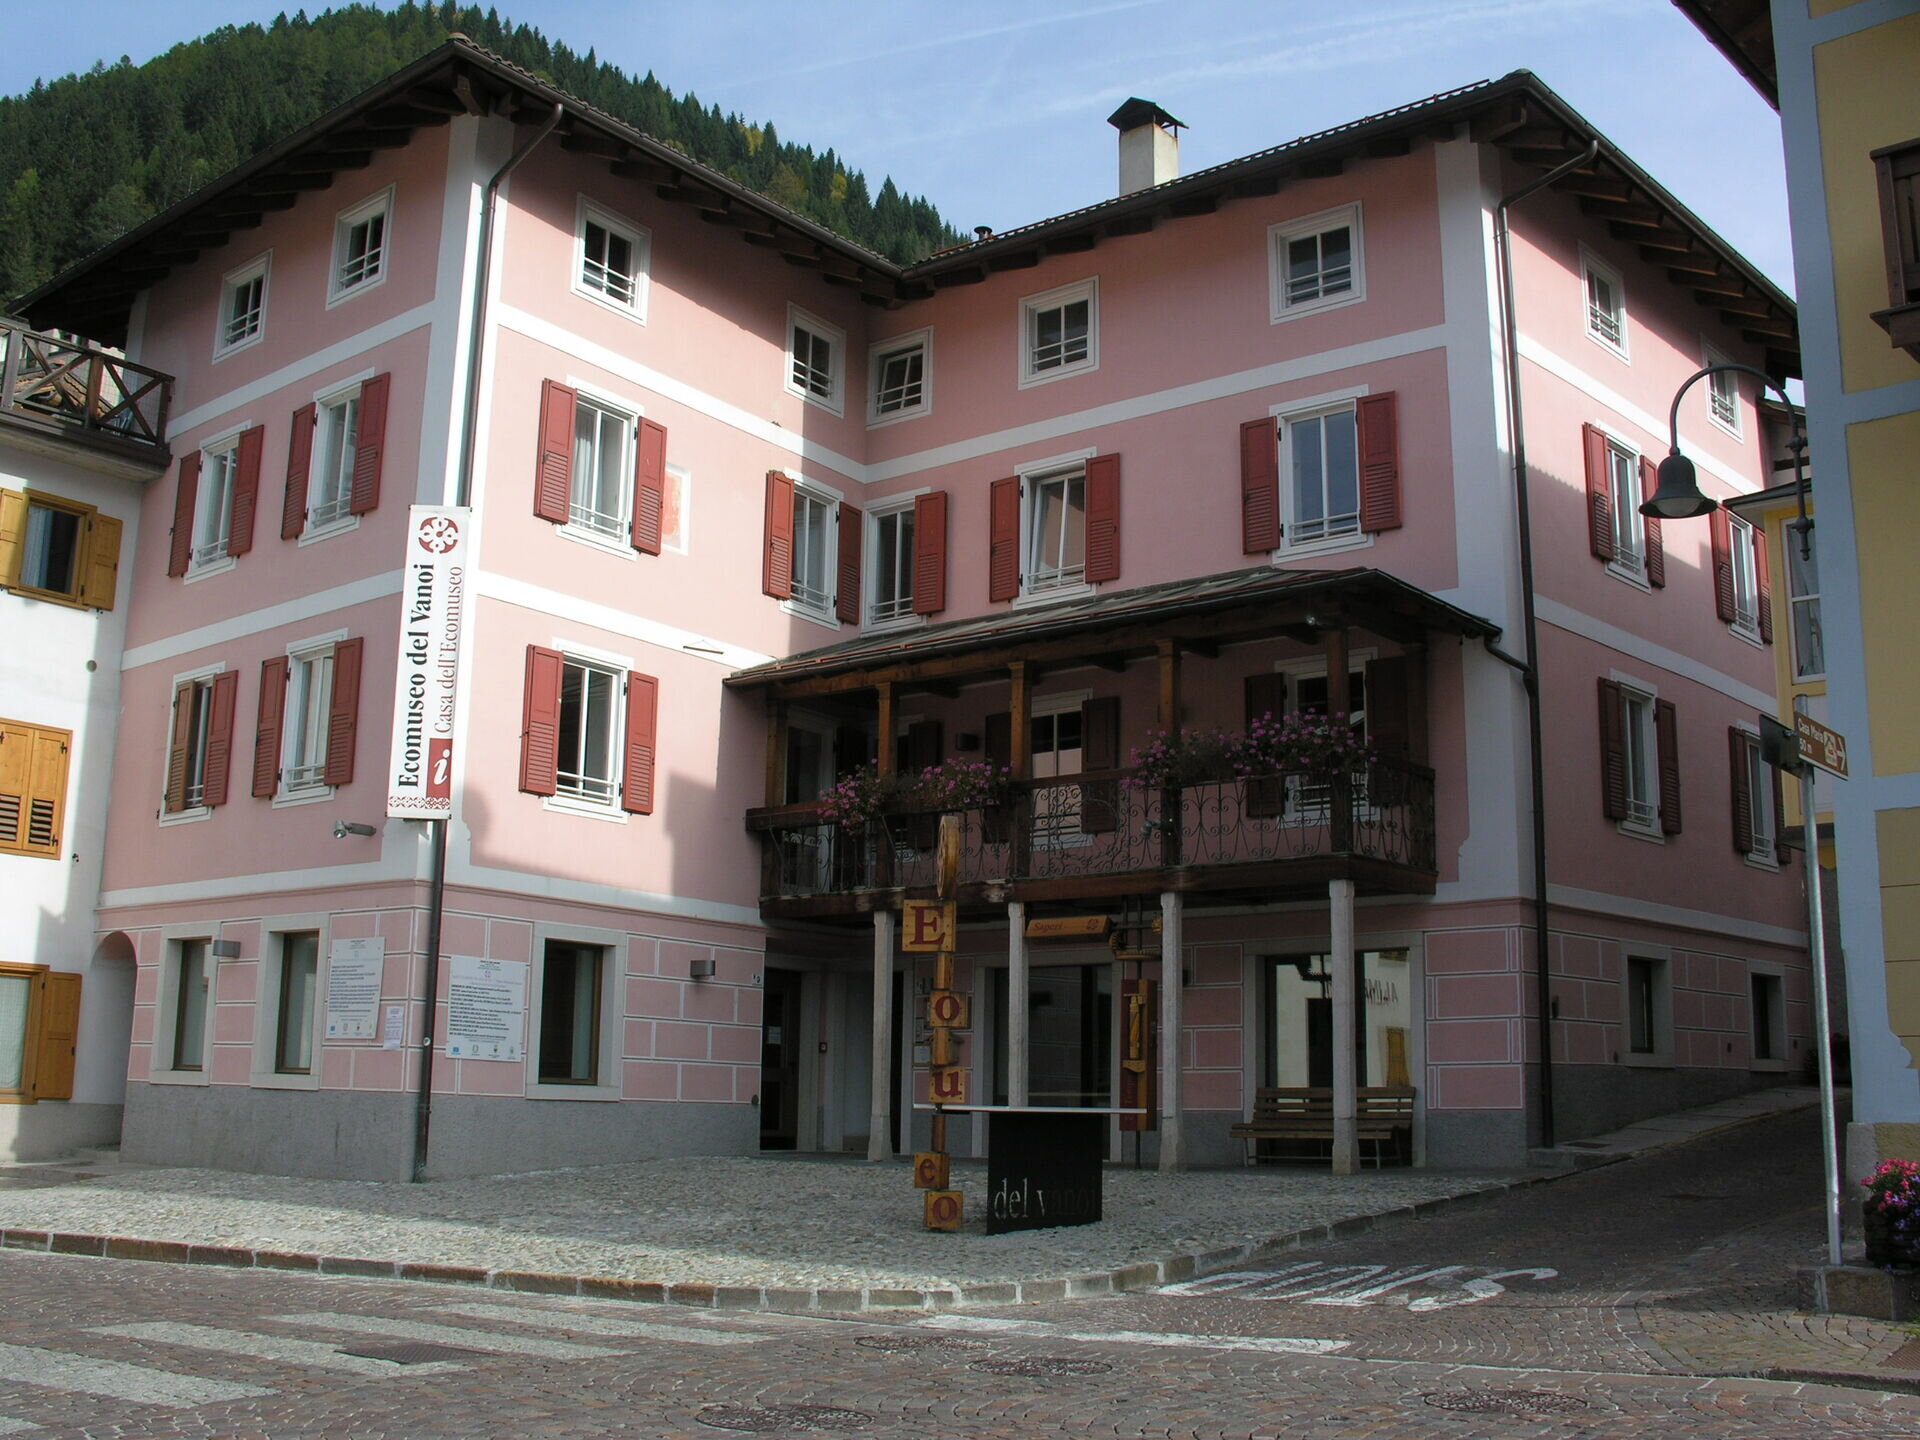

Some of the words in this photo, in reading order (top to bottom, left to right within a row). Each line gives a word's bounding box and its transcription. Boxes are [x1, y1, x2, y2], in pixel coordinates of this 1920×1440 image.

[410, 563, 434, 624] Vanoi
[406, 631, 429, 666] del
[437, 566, 463, 689] dell'Ecomuseo
[398, 673, 427, 787] Ecomuseo
[434, 695, 454, 733] Casa
[993, 1176, 1029, 1220] del
